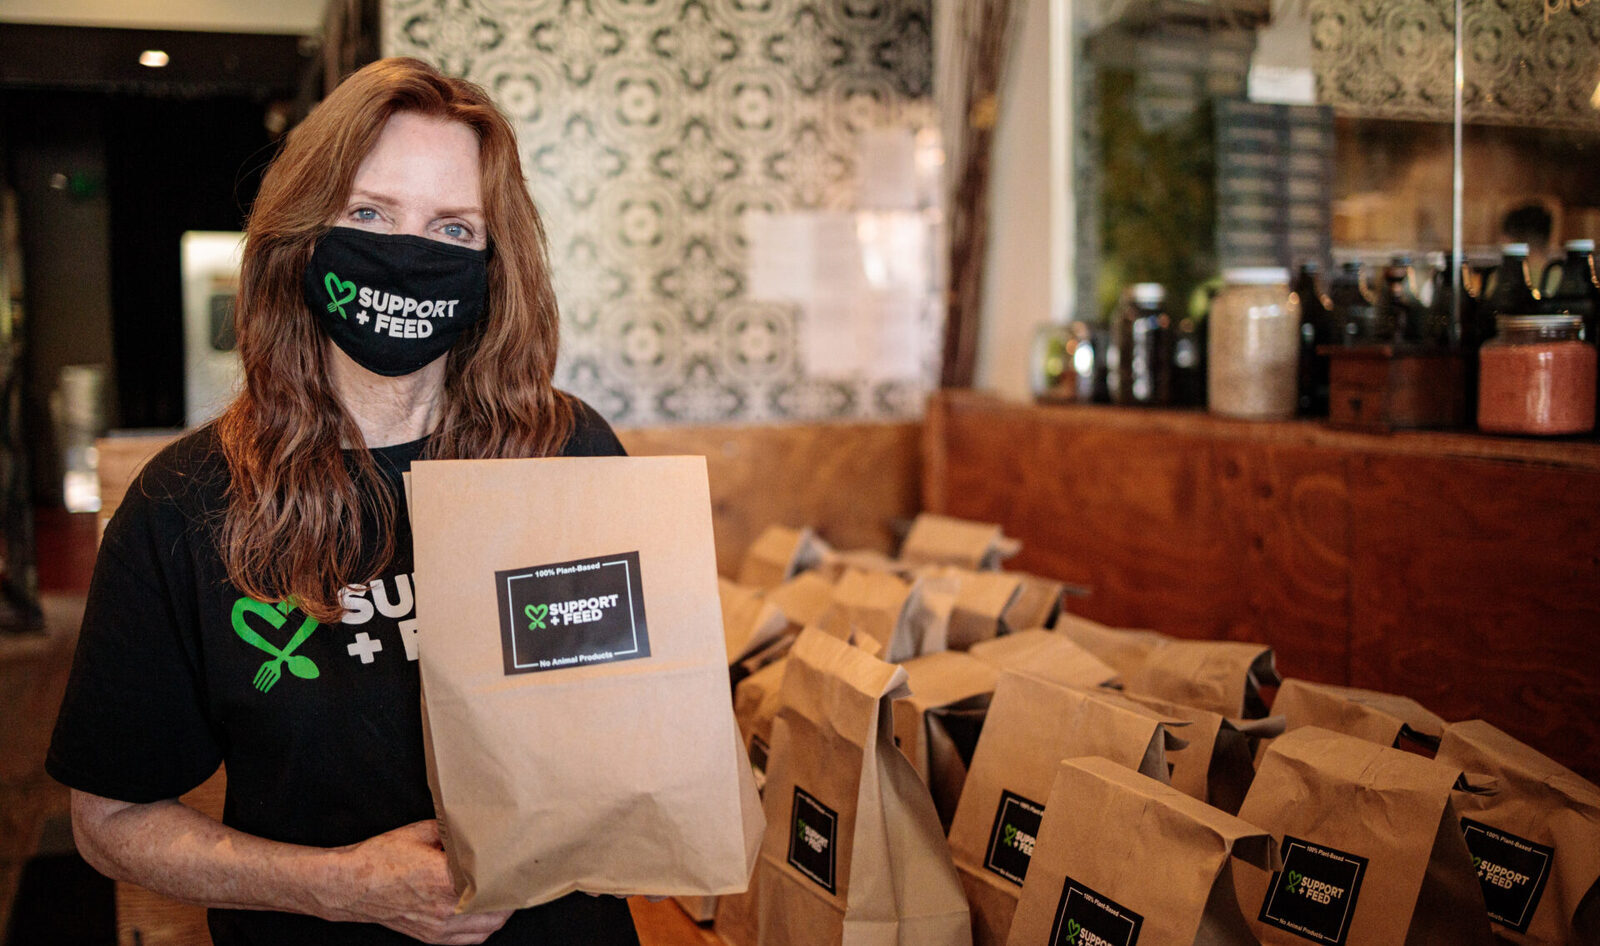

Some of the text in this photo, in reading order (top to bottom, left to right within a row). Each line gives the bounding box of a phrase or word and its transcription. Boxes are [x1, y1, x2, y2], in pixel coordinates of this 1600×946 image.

[359, 287, 459, 318] SUPPORT
[374, 313, 433, 338] FEED
[535, 562, 601, 578] 100% Plant-Based
[549, 594, 618, 616] SUPPORT
[563, 610, 603, 626] FEED
[540, 652, 613, 668] No Animal Products
[1486, 830, 1533, 852] 100% Plant-Based
[1318, 849, 1344, 861] Plant-Based
[1480, 860, 1530, 886] SUPPORT
[1485, 872, 1513, 889] FEED
[1301, 876, 1344, 899] SUPPORT
[1306, 888, 1331, 905] FEED
[1083, 893, 1120, 917] 100% Plant-Based
[1286, 920, 1303, 931] Animal
[1303, 926, 1324, 939] Products
